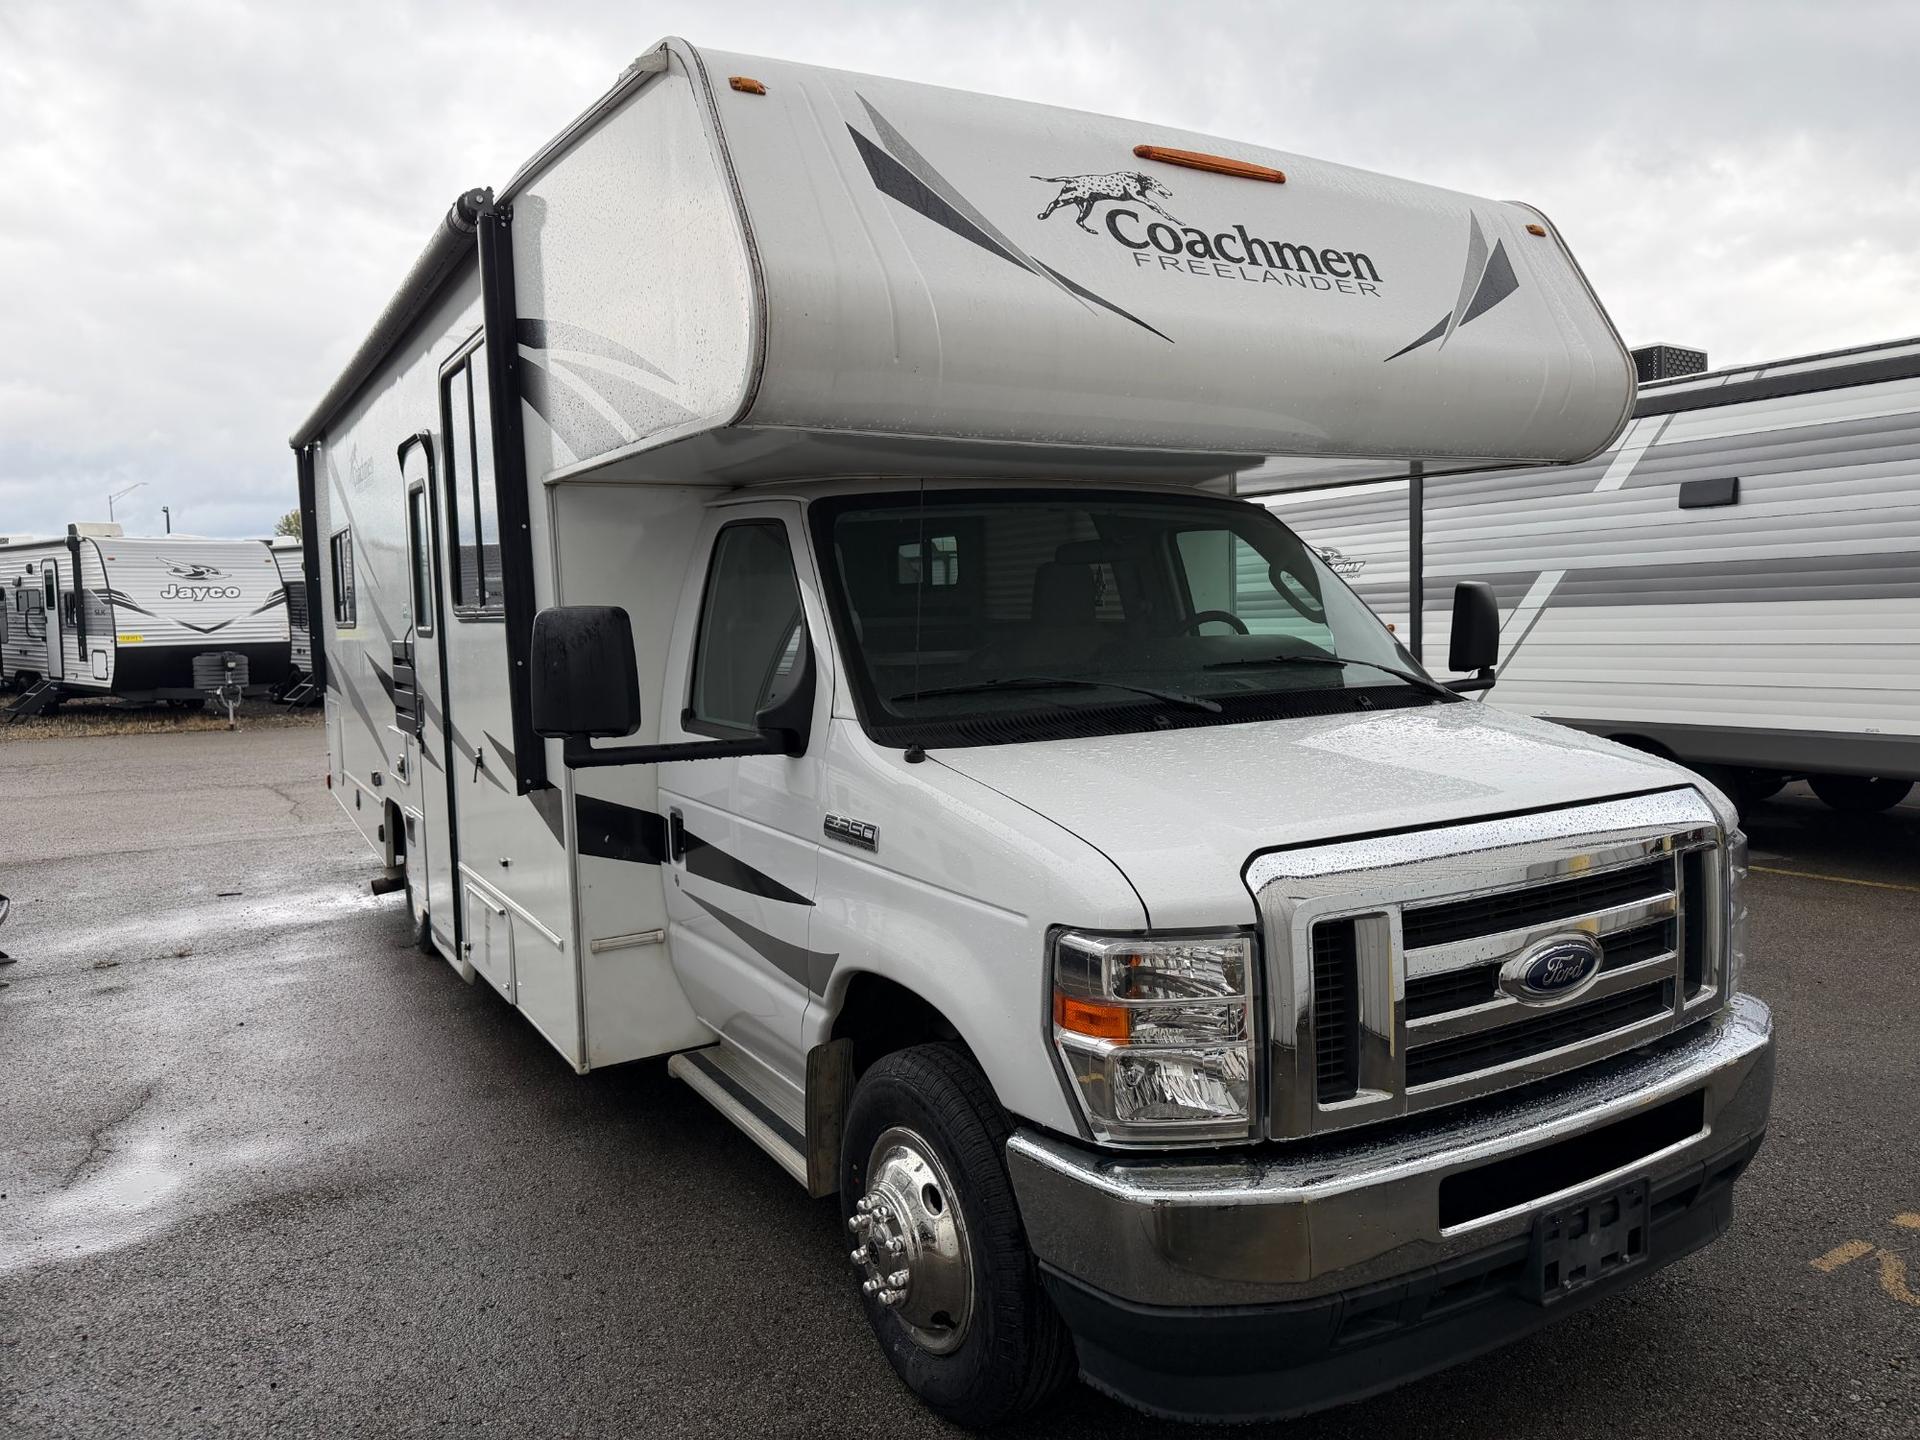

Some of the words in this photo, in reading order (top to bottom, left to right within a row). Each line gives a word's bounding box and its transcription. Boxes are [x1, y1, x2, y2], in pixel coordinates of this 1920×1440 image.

[1105, 208, 1384, 283] Coachmen
[1132, 252, 1382, 298] FREELANDER
[1331, 560, 1366, 574] IGHT
[160, 583, 241, 601] Jayco
[1542, 954, 1585, 986] Ford
